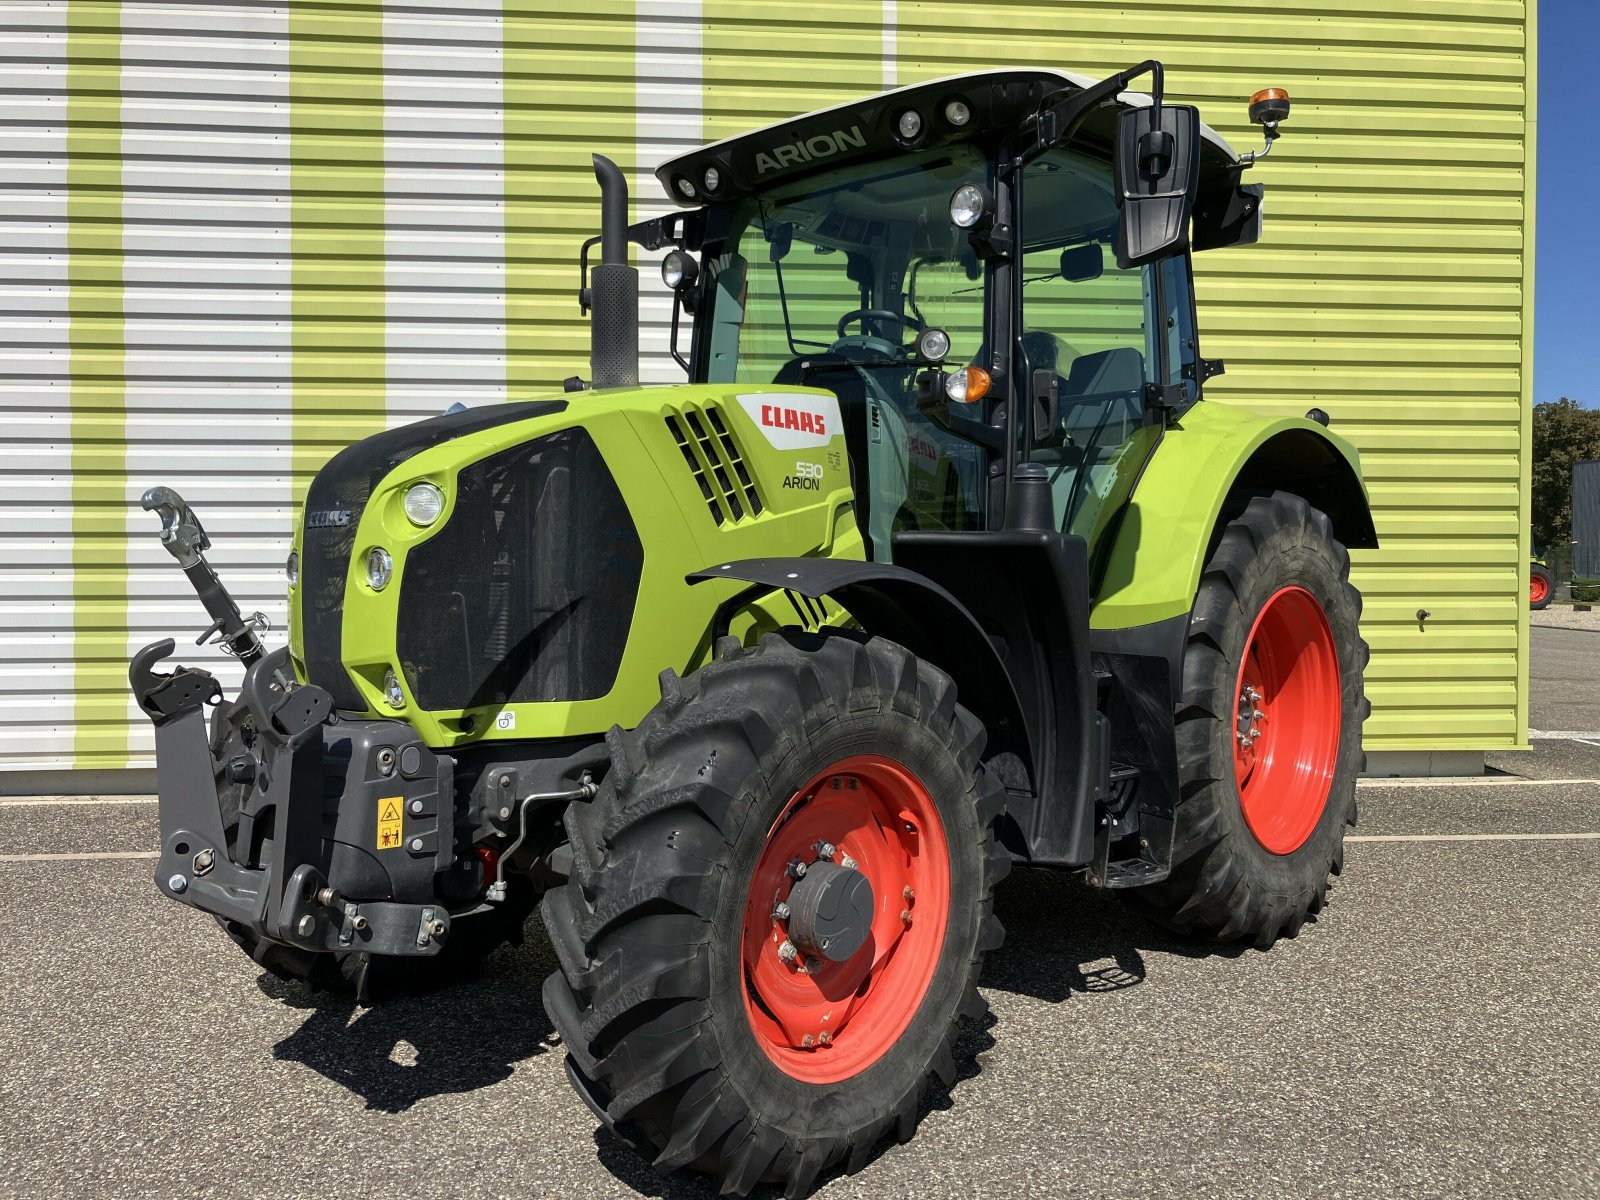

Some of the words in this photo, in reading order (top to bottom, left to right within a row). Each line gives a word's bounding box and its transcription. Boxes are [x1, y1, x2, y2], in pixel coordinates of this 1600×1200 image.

[755, 125, 867, 174] ARION
[761, 404, 826, 436] CLAAS
[795, 461, 824, 479] 530
[782, 475, 820, 491] ARION
